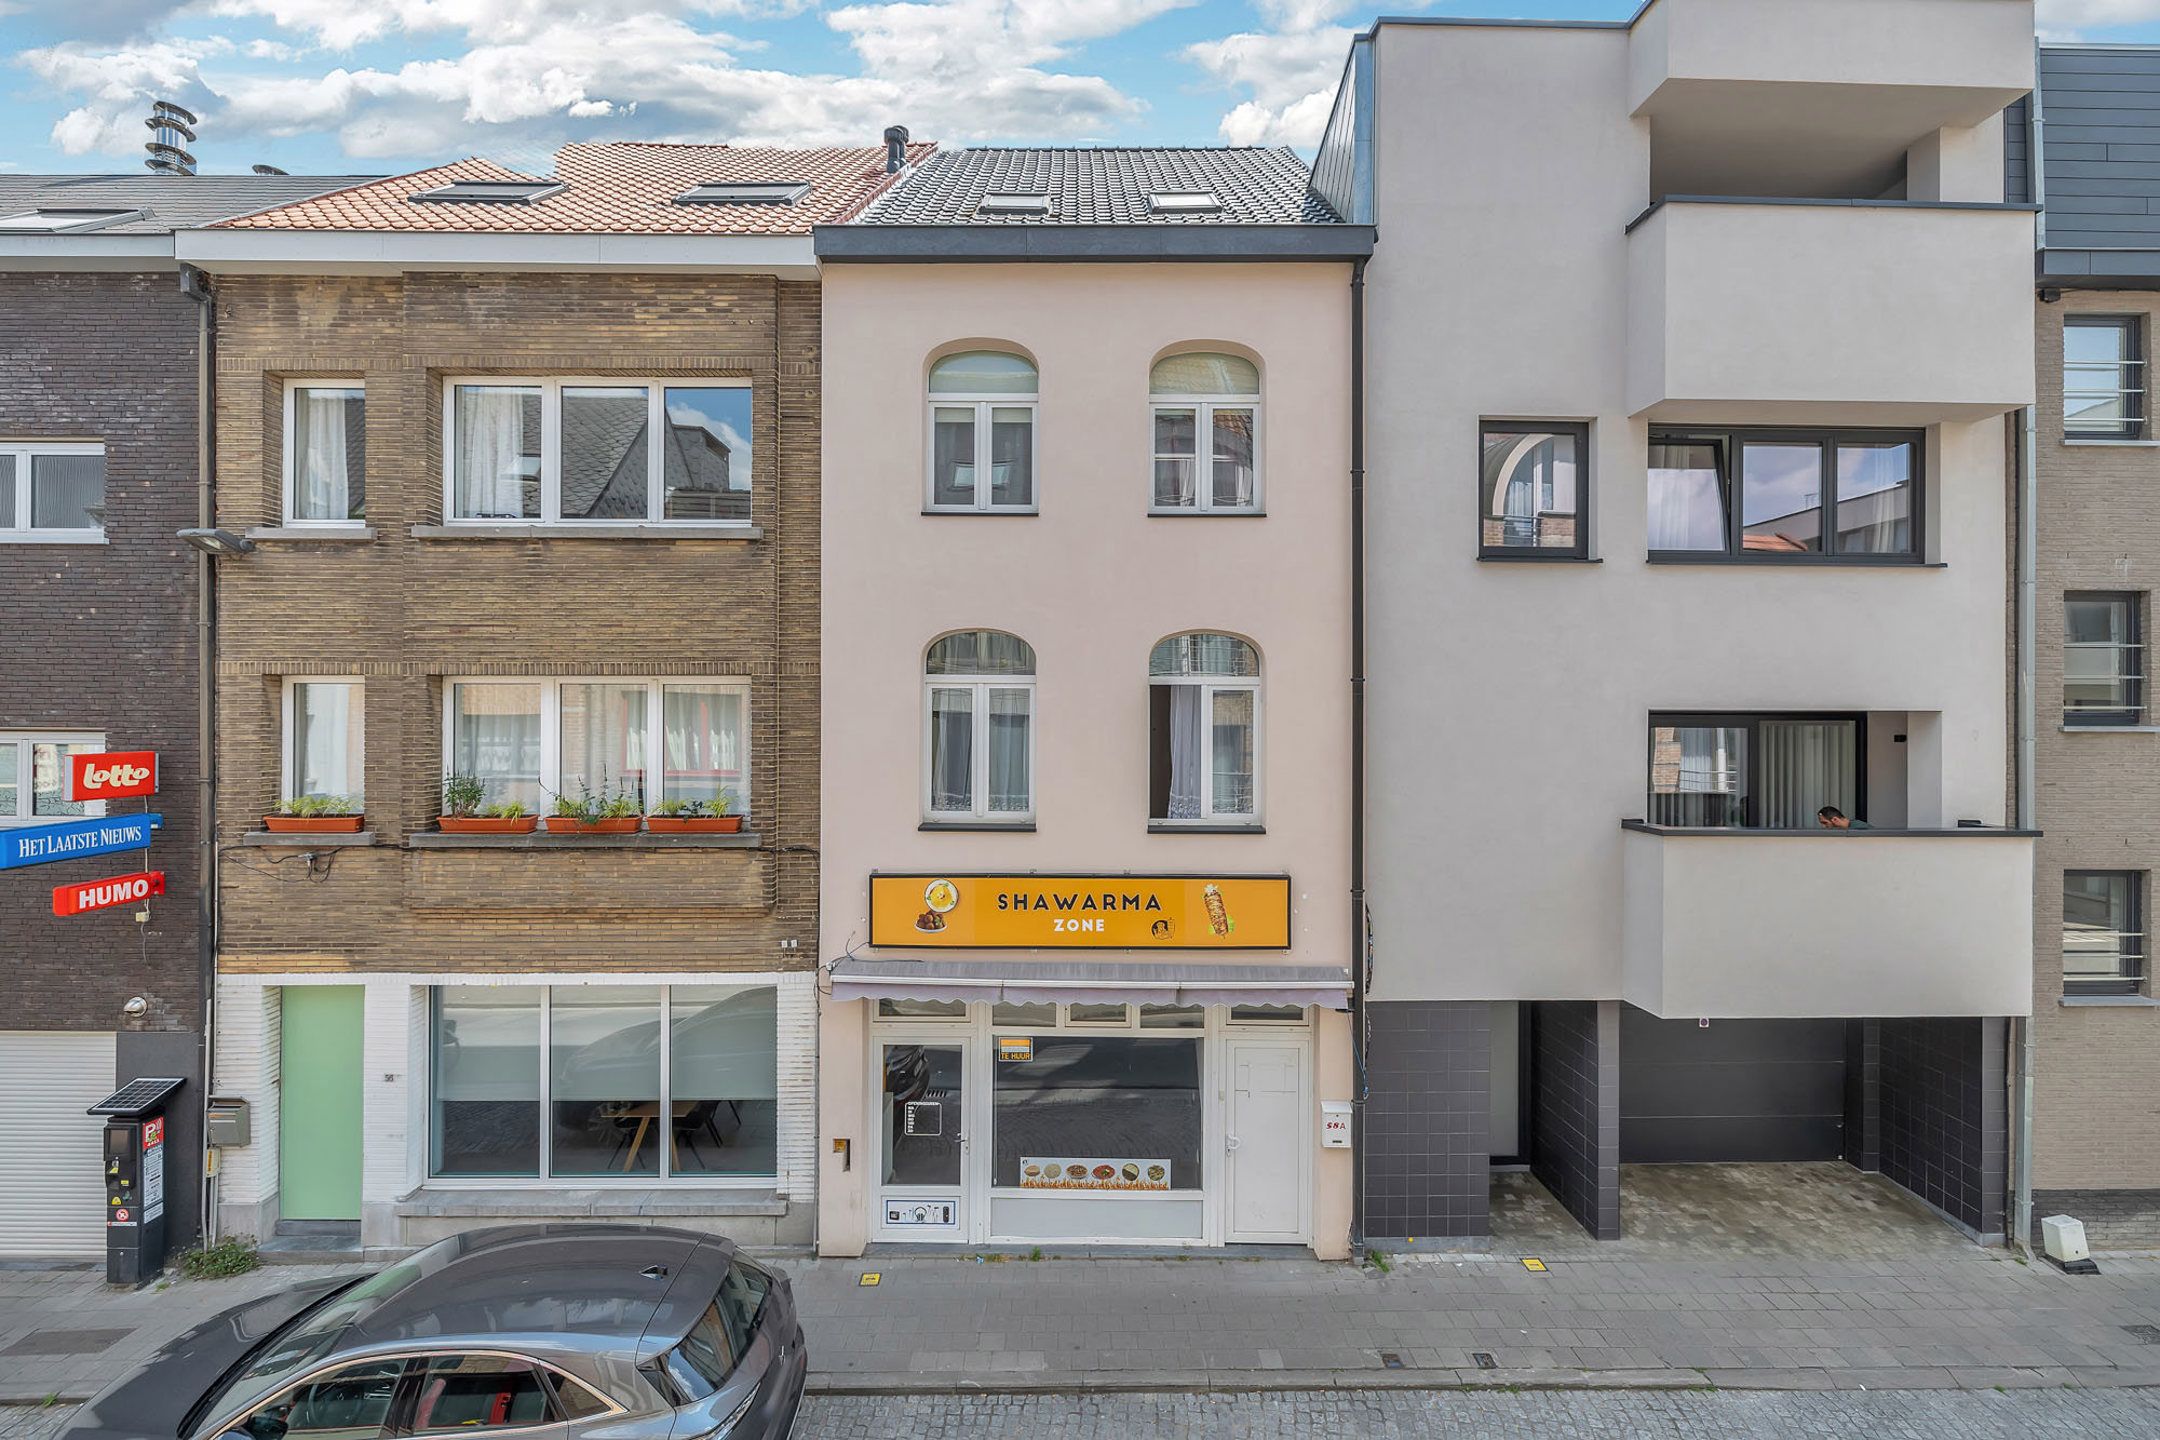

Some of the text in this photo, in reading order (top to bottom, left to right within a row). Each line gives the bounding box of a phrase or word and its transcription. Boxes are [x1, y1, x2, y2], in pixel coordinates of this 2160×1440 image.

[19, 826, 142, 858] HET LAATSTE NIEUWS
[79, 879, 149, 909] HUMO
[998, 893, 1162, 911] SHAWARMA
[1053, 918, 1105, 932] ZONE
[1001, 1052, 1030, 1060] TE HUUR
